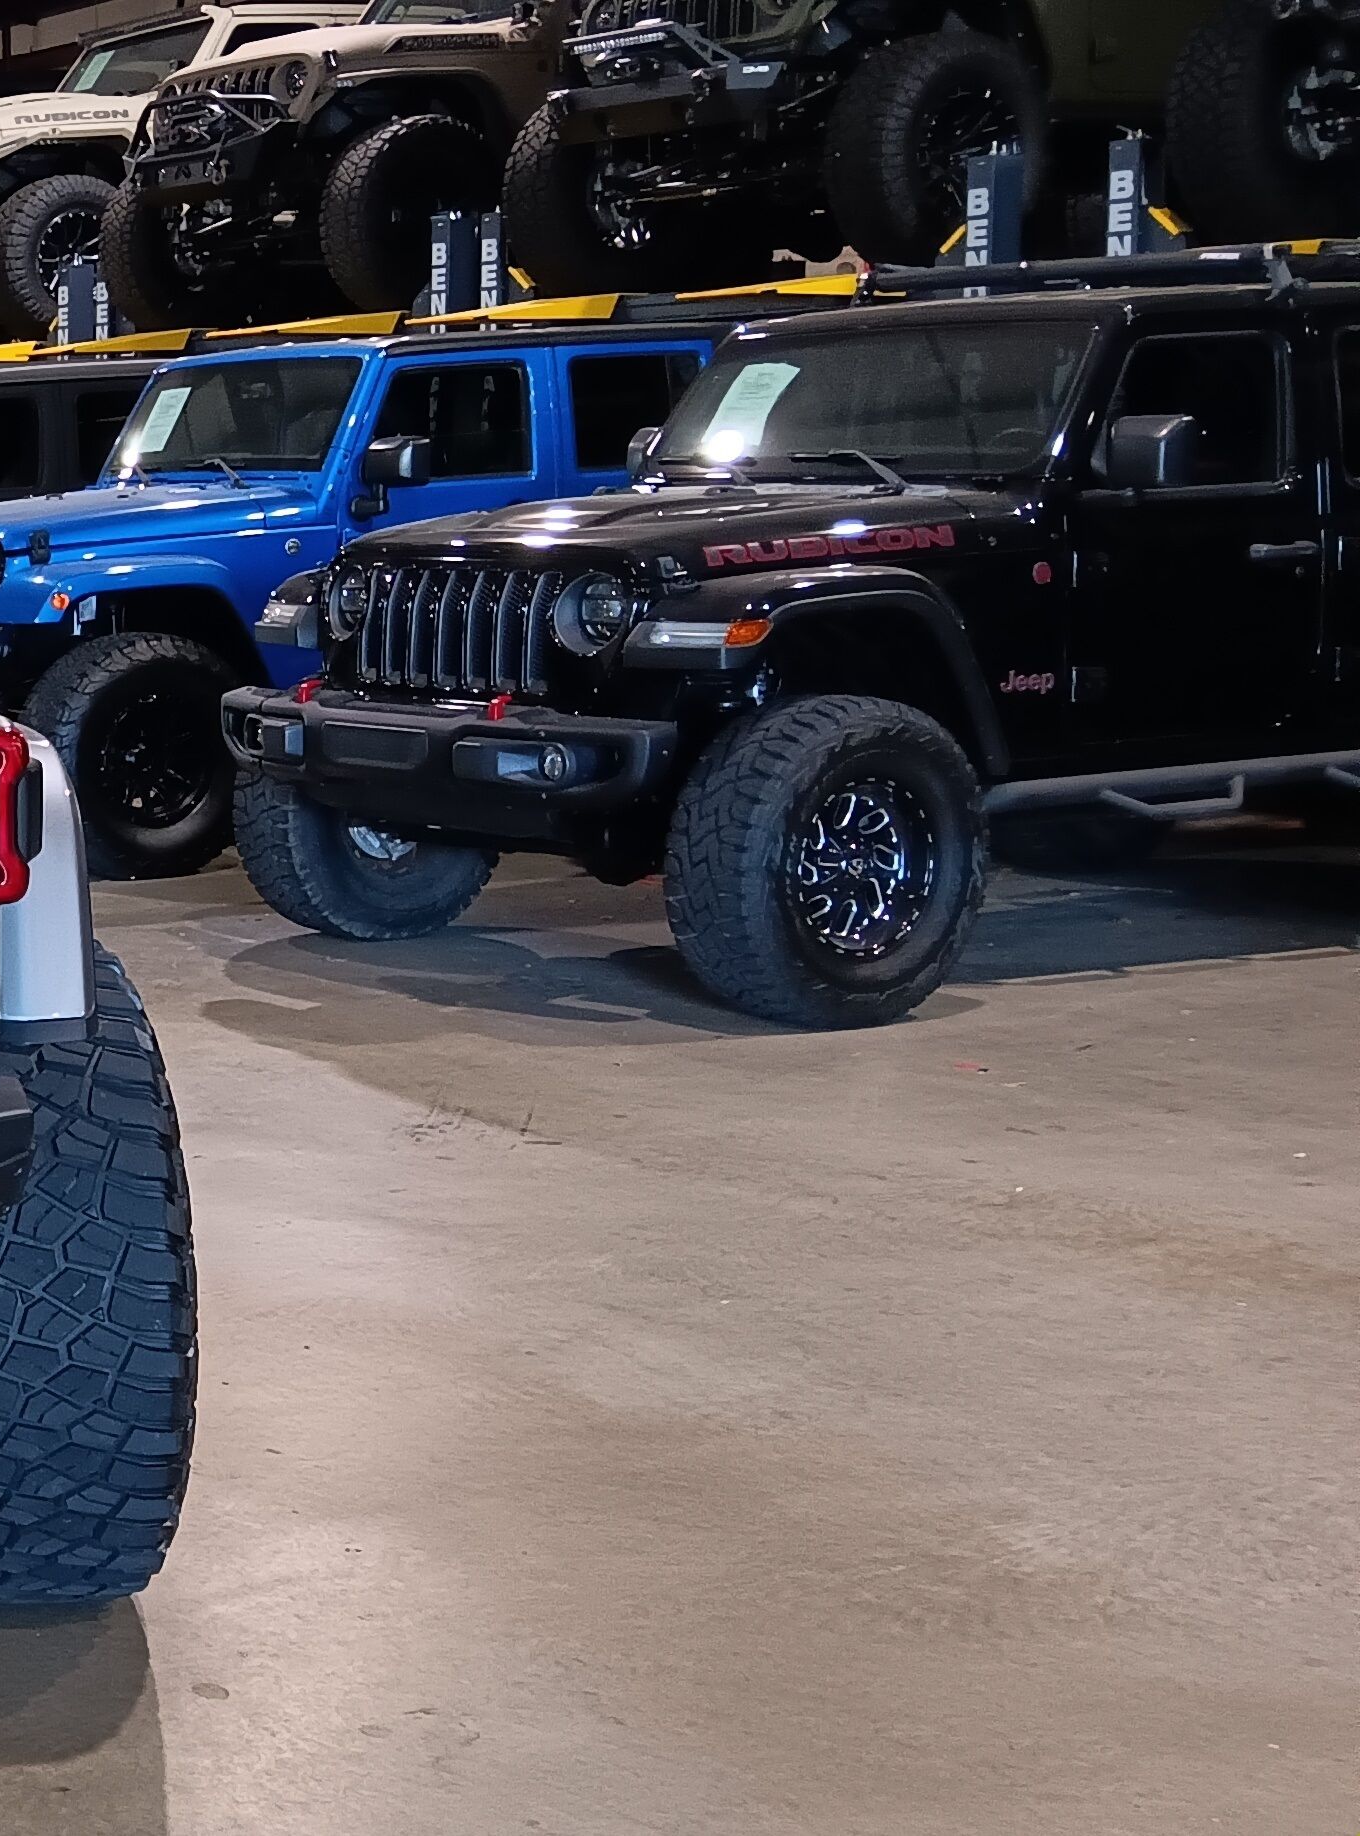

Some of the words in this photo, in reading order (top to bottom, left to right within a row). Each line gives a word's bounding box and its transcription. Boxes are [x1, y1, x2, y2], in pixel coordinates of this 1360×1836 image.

[14, 109, 129, 125] RUBICON
[702, 524, 955, 567] RUBICON
[999, 669, 1055, 695] Jeep
